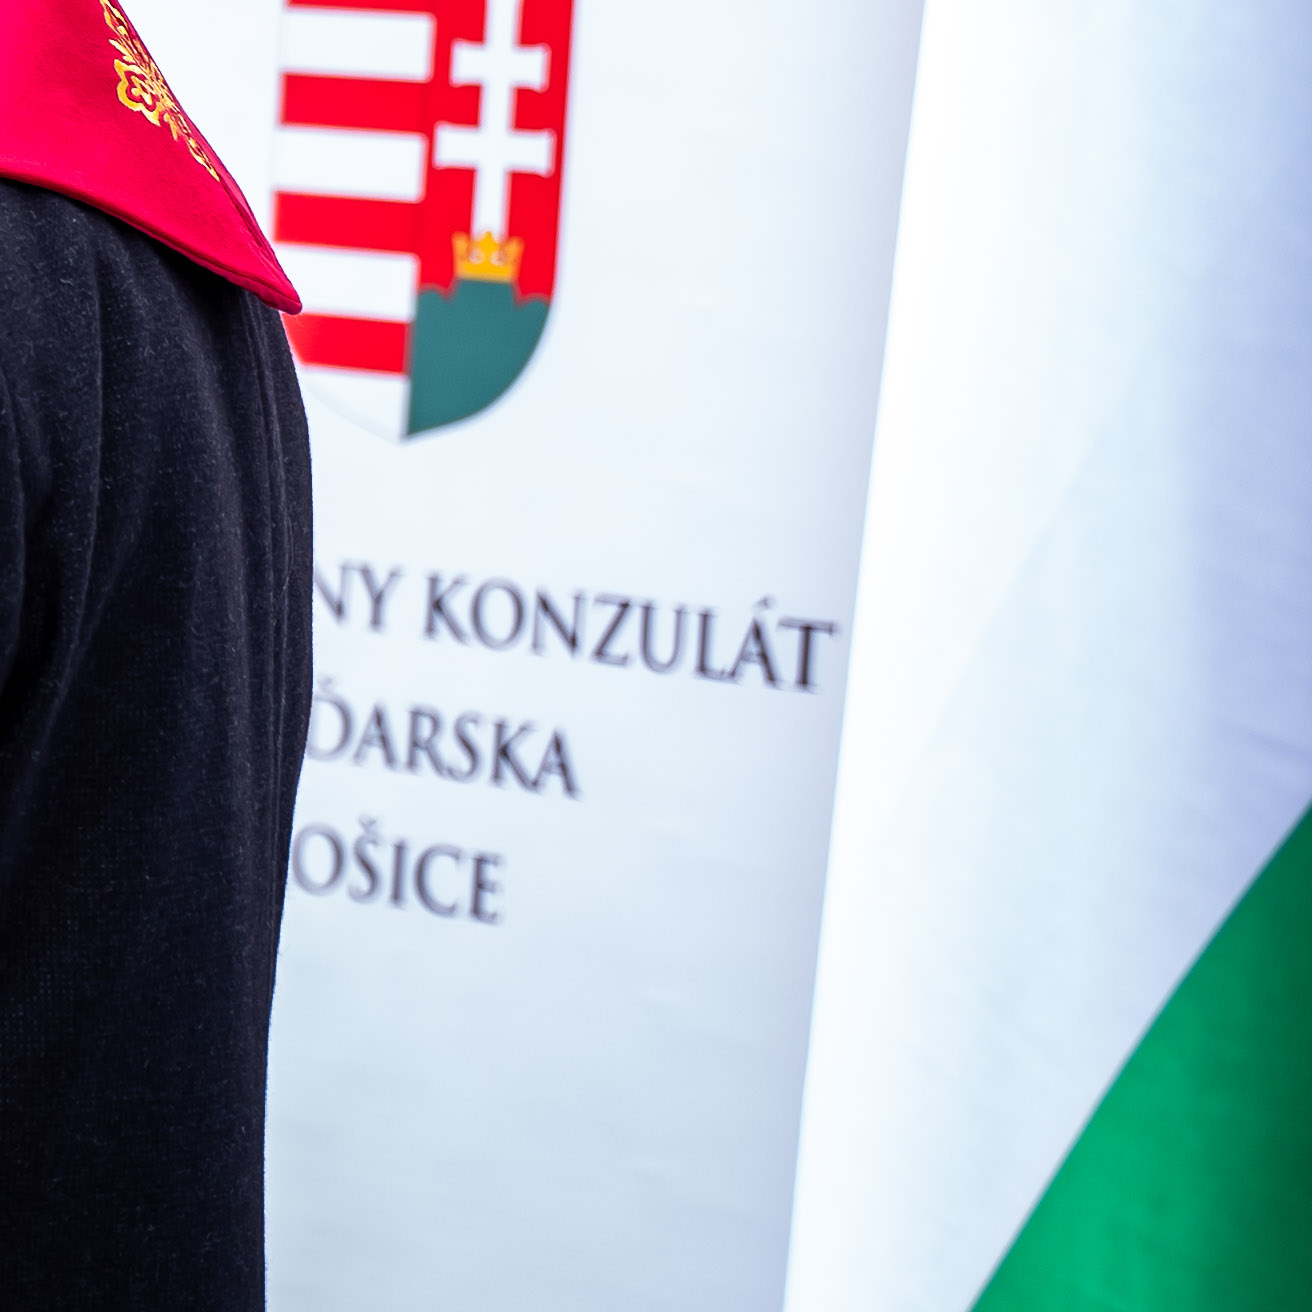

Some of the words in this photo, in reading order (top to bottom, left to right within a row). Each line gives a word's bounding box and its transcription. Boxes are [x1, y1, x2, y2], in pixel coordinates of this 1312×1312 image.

[313, 561, 405, 633] NY
[423, 570, 840, 694] KONZULÁT
[307, 676, 582, 800] ĎARSKA
[291, 813, 505, 925] OŠICE
